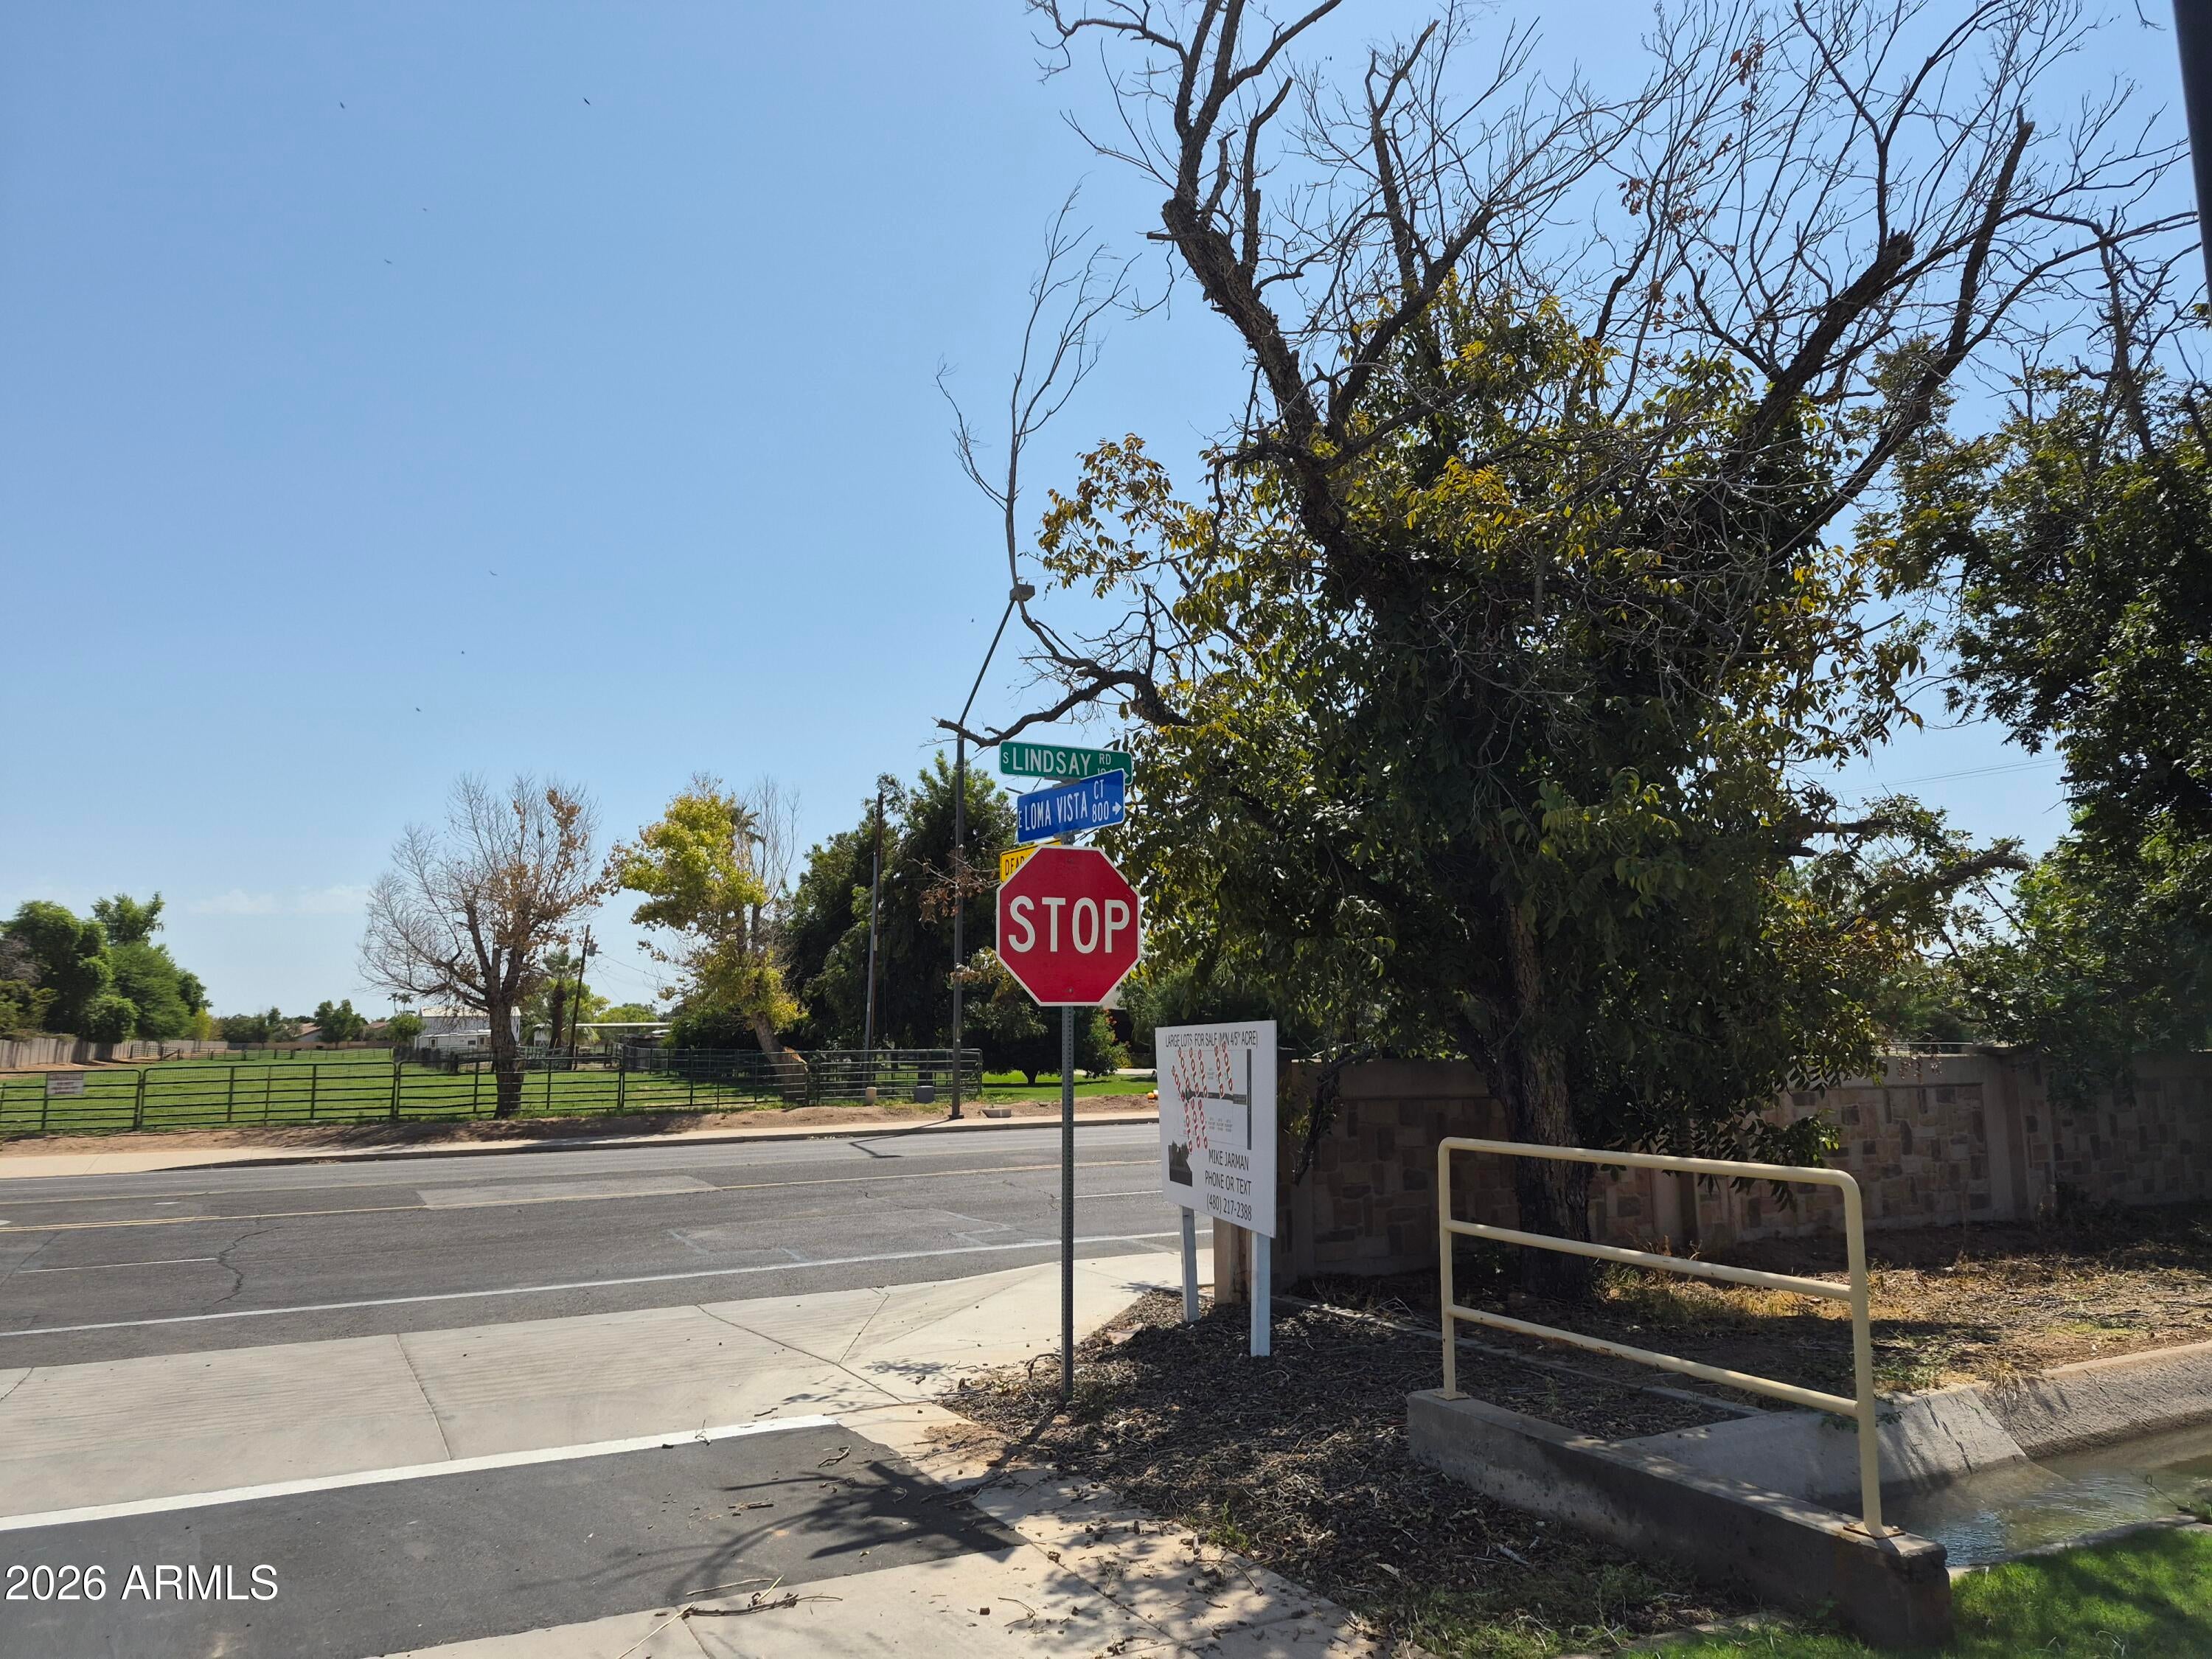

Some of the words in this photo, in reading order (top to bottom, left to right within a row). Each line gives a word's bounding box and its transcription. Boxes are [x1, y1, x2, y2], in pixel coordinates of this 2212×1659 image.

[1003, 751, 1009, 764] S
[1012, 747, 1091, 776] LINDSAY
[1099, 753, 1111, 765] RD
[1018, 810, 1023, 828] E
[1025, 799, 1051, 831] LOMA
[1057, 790, 1088, 824] VISTA
[1093, 779, 1105, 800] CT
[1092, 801, 1110, 823] 800
[1008, 895, 1130, 954] STOP
[1165, 1034, 1180, 1047] LARGE
[1180, 1033, 1193, 1047] LOTS
[1194, 1032, 1205, 1047] FOR
[1206, 1032, 1217, 1046] SALE
[1242, 1030, 1258, 1048] ACRE)
[1208, 1149, 1223, 1166] MIKE
[1225, 1154, 1249, 1171] JARMAN
[1205, 1170, 1224, 1189] PHONE
[1225, 1175, 1234, 1192] OR
[1236, 1178, 1252, 1196] TEXT
[1206, 1193, 1222, 1214] (480)
[1223, 1198, 1252, 1221] 217-2388
